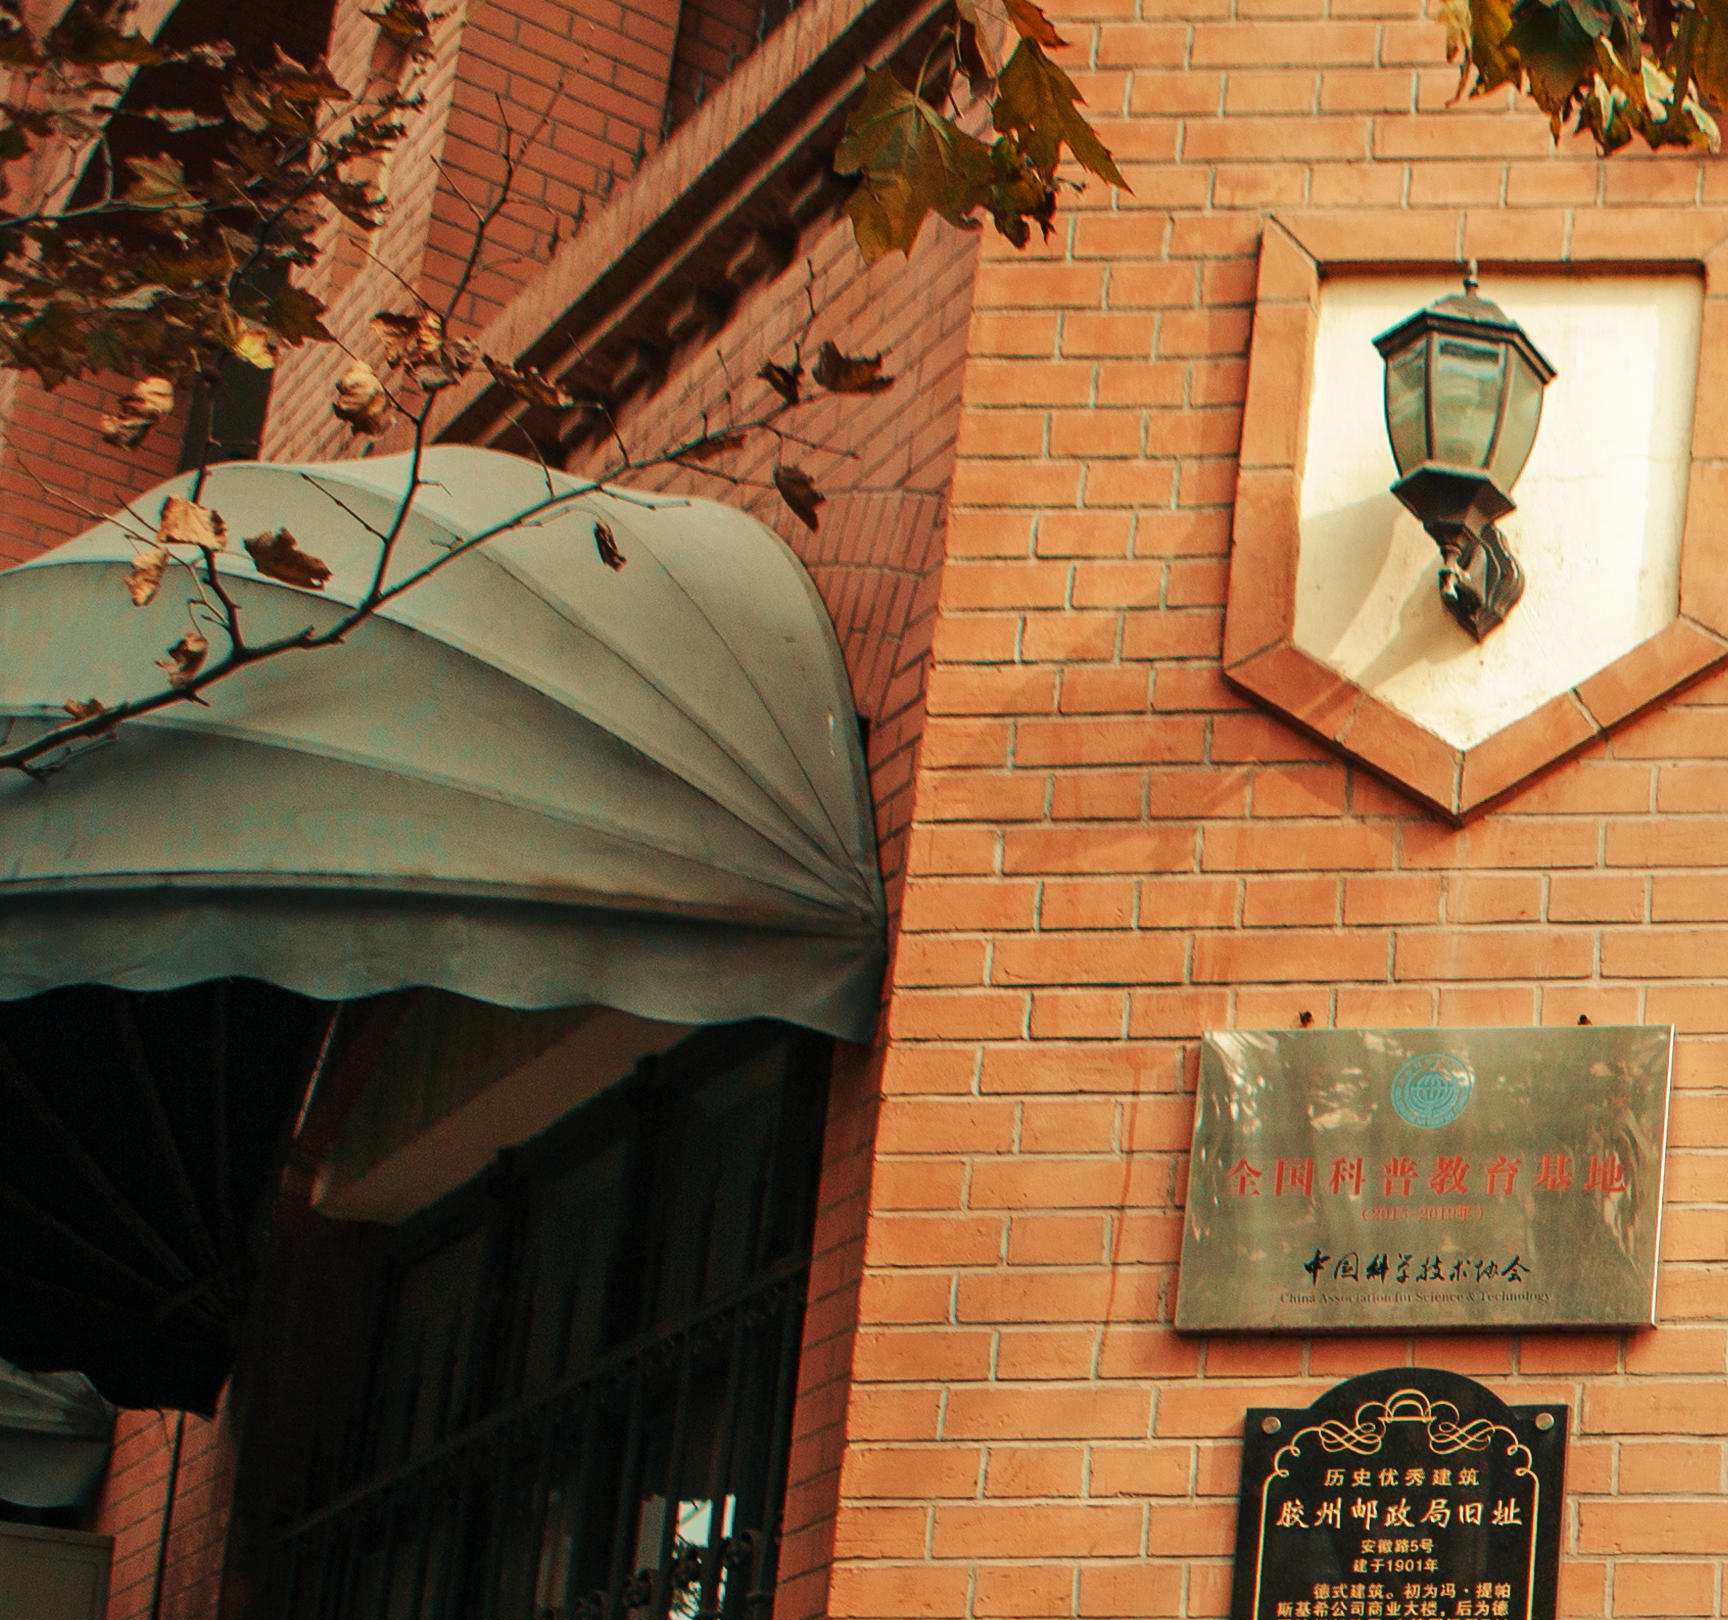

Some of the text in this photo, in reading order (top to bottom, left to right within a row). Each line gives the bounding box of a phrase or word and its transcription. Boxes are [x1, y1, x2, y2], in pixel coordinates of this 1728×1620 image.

[1224, 1153, 1627, 1198] 全国科普教育基地
[1304, 1249, 1531, 1287] 中国科学技术协会
[1280, 1293, 1316, 1304] China
[1416, 1292, 1464, 1303] Science
[1480, 1290, 1550, 1304] Technology
[1323, 1467, 1481, 1487] 历史优秀建筑
[1275, 1496, 1523, 1531] 胶州邮政局旧址
[1360, 1538, 1435, 1554] 安徽路5号
[1353, 1558, 1439, 1574] 建于1901年
